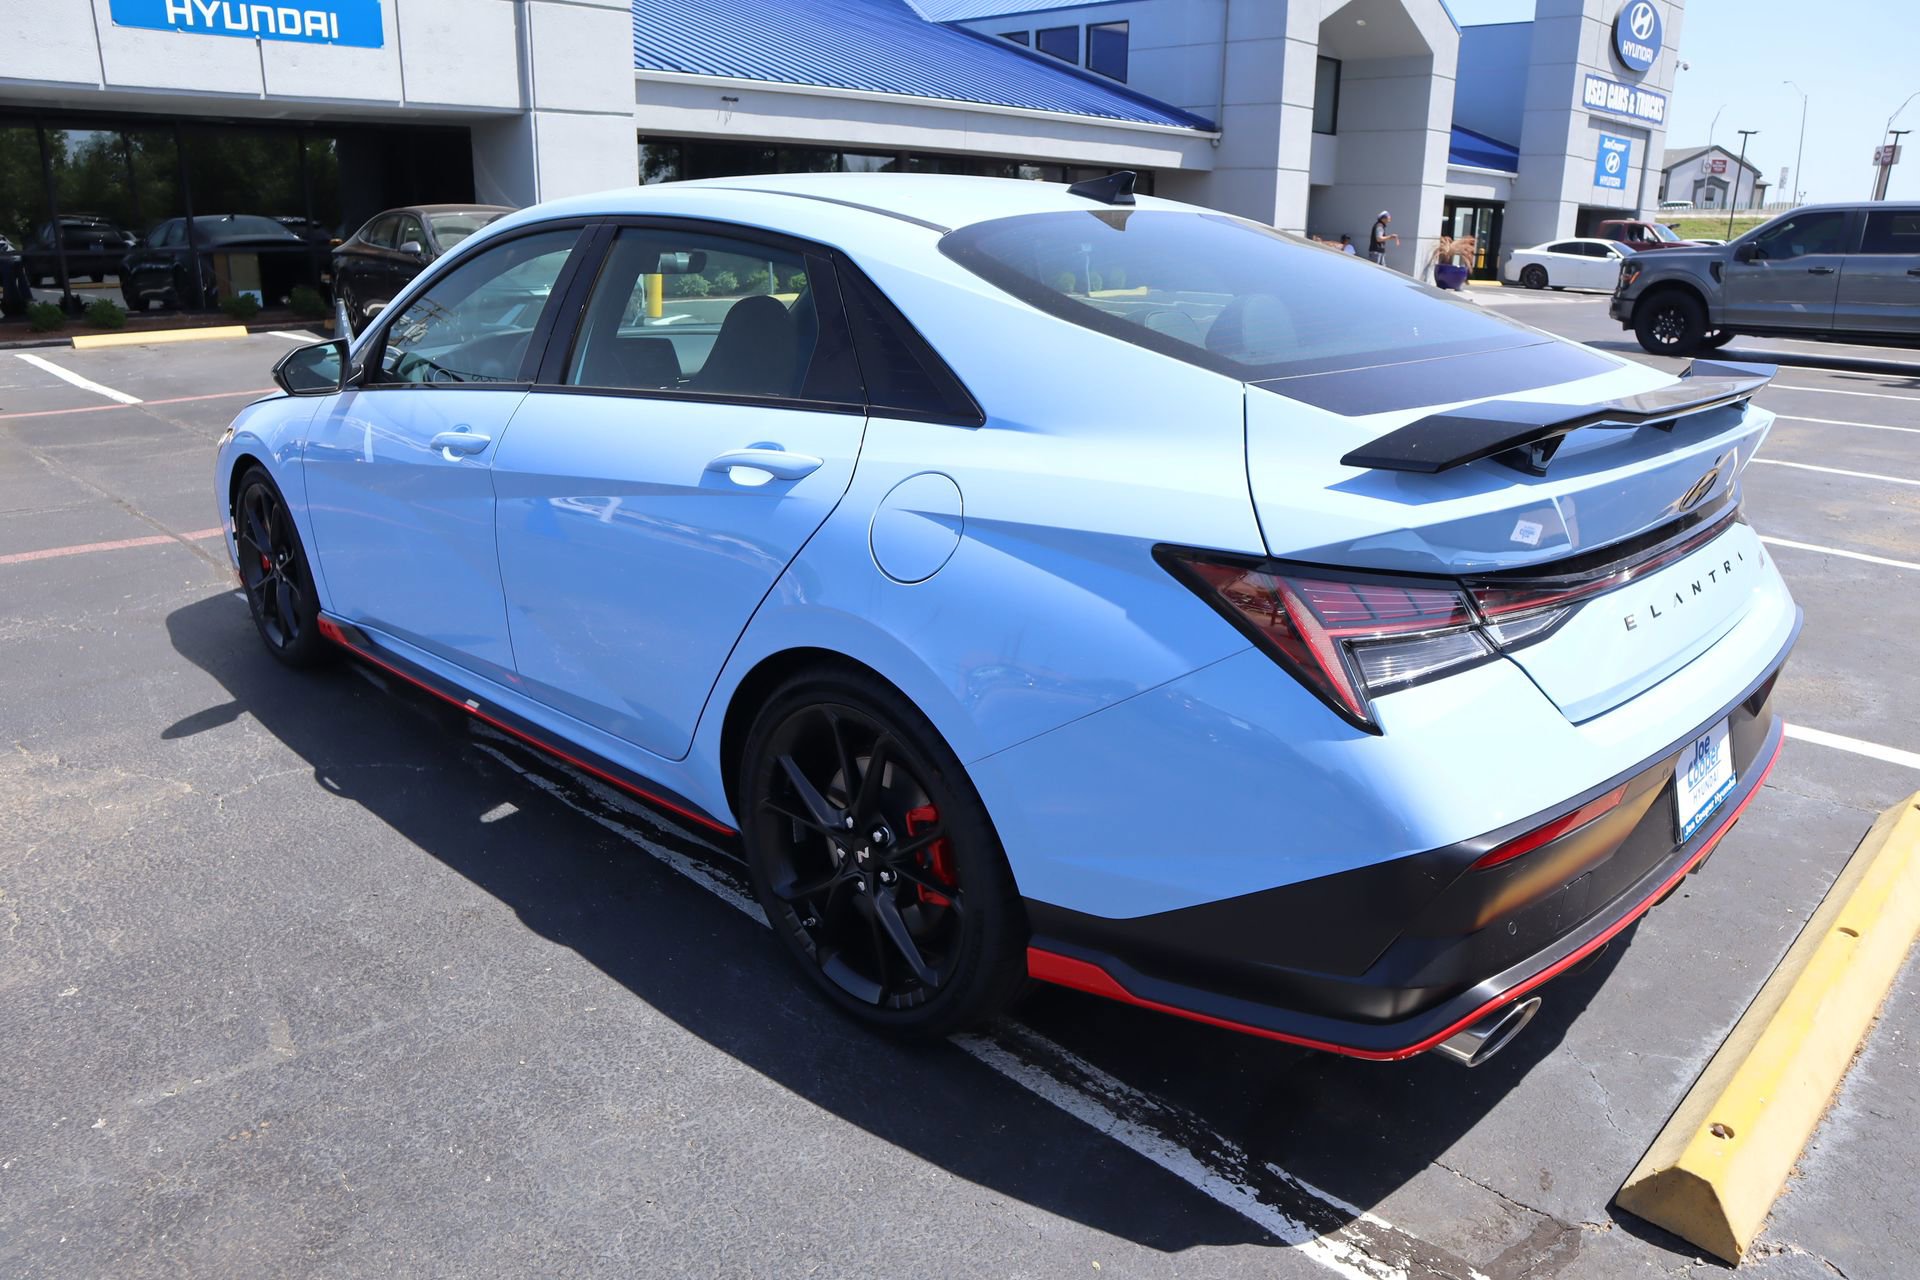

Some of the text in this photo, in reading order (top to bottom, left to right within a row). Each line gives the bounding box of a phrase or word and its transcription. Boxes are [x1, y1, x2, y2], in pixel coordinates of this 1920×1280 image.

[165, 0, 339, 39] HYUNDAI
[1622, 40, 1654, 63] HYUNDAI
[1584, 77, 1664, 122] USED CARS & TRUCKS
[1687, 744, 1720, 788] Cooper
[1693, 735, 1710, 763] Joe
